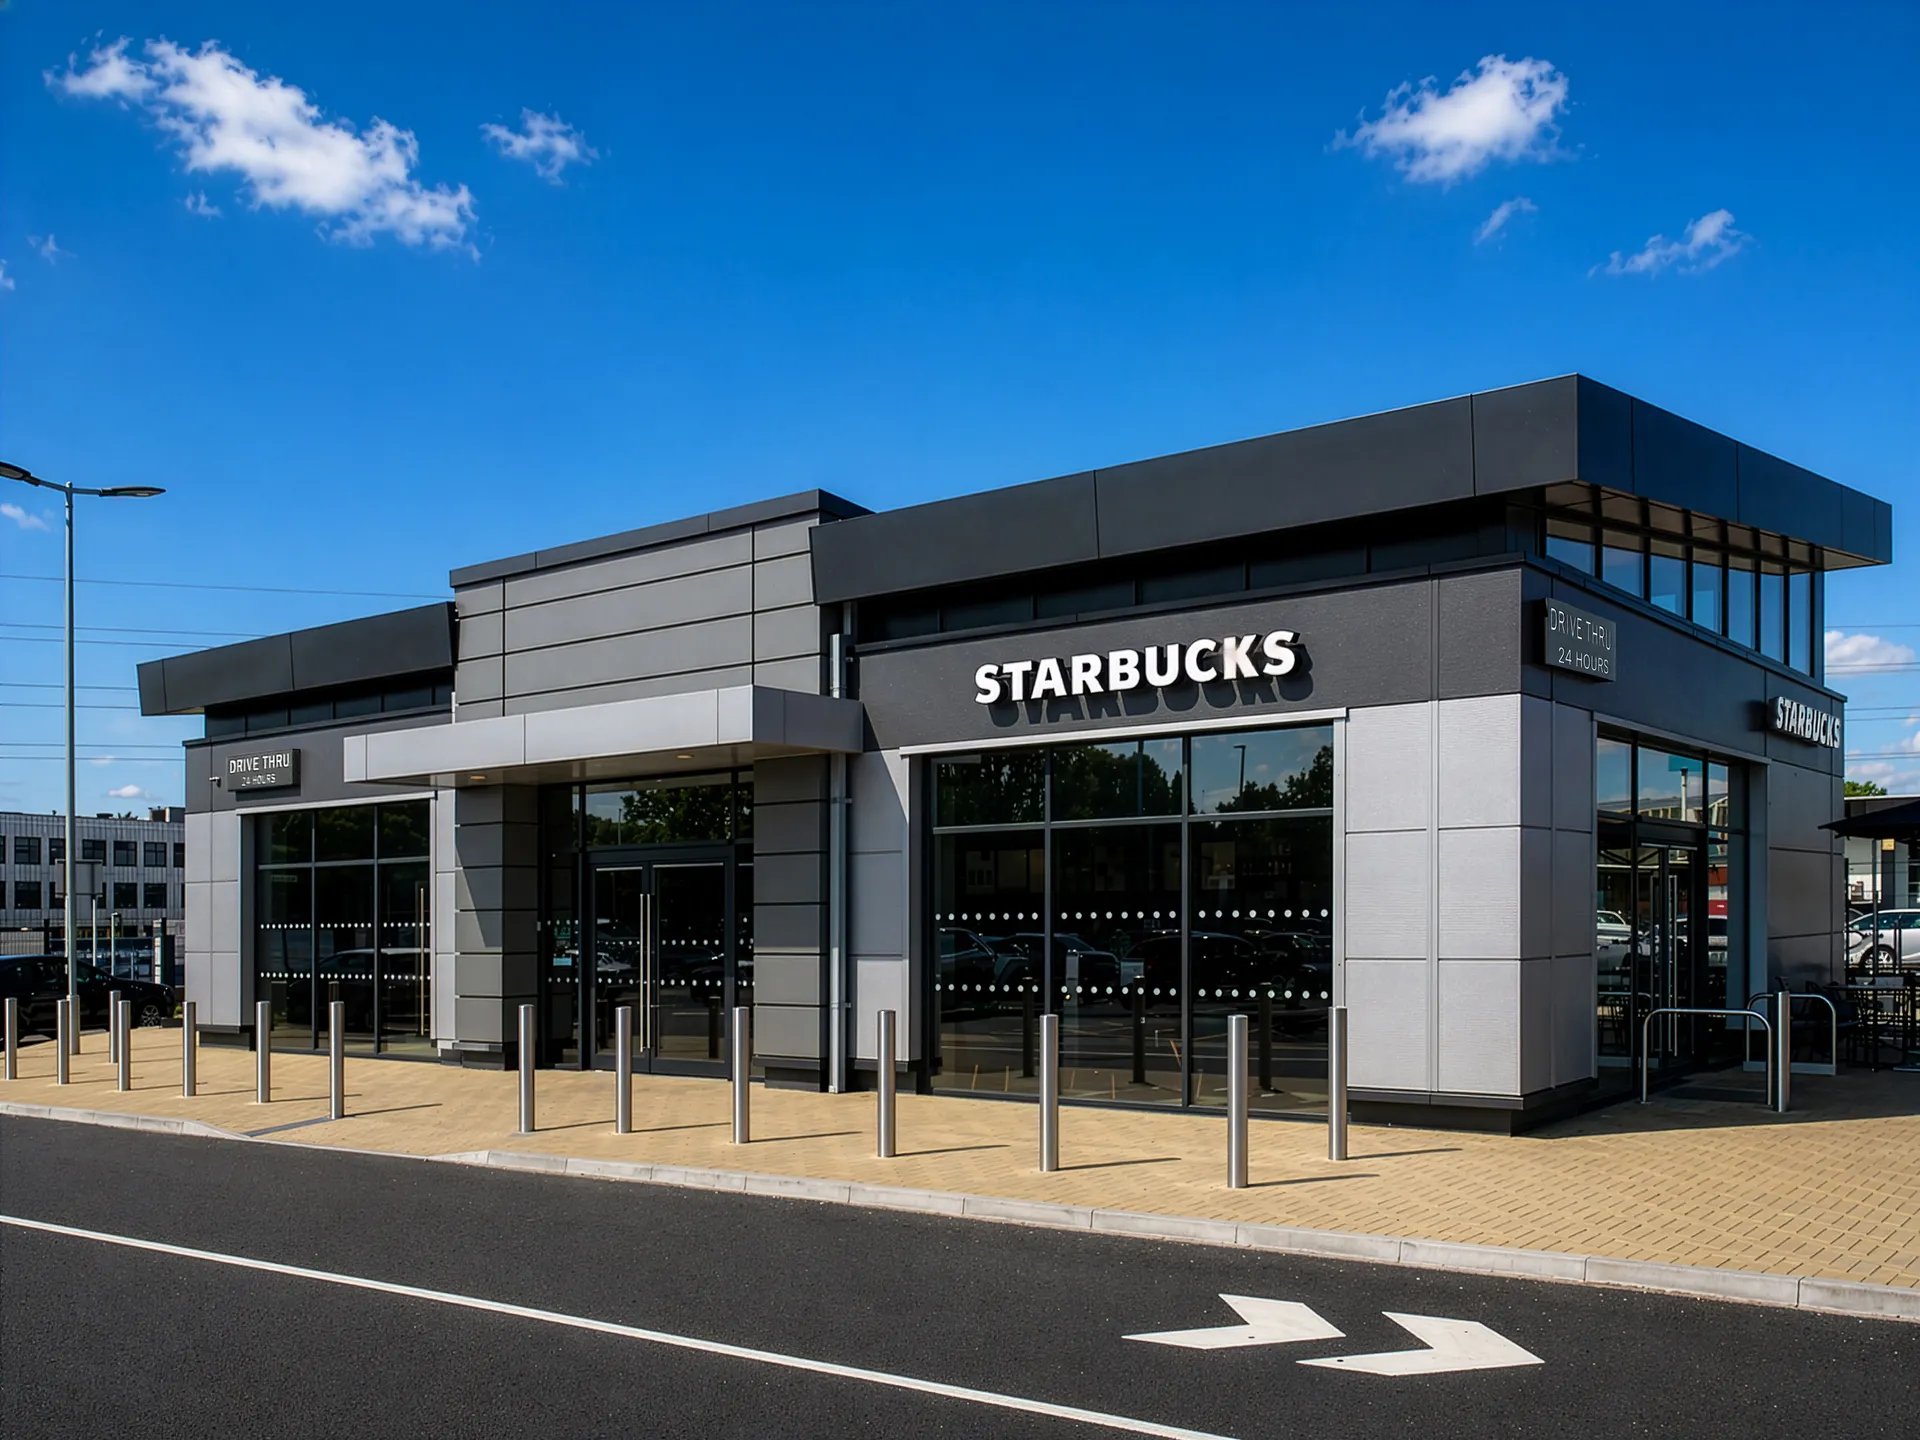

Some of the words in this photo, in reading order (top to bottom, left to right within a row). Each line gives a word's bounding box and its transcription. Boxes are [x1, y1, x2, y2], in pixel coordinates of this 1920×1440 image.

[1550, 607, 1583, 640] DRIVE
[1585, 620, 1612, 651] THRU
[974, 629, 1297, 705] STARBUCKS
[1558, 646, 1572, 665] 24
[1575, 651, 1609, 675] HOURS
[1776, 696, 1840, 748] STARBUCKS
[229, 757, 260, 774] DRIVE
[262, 753, 290, 769] THRU
